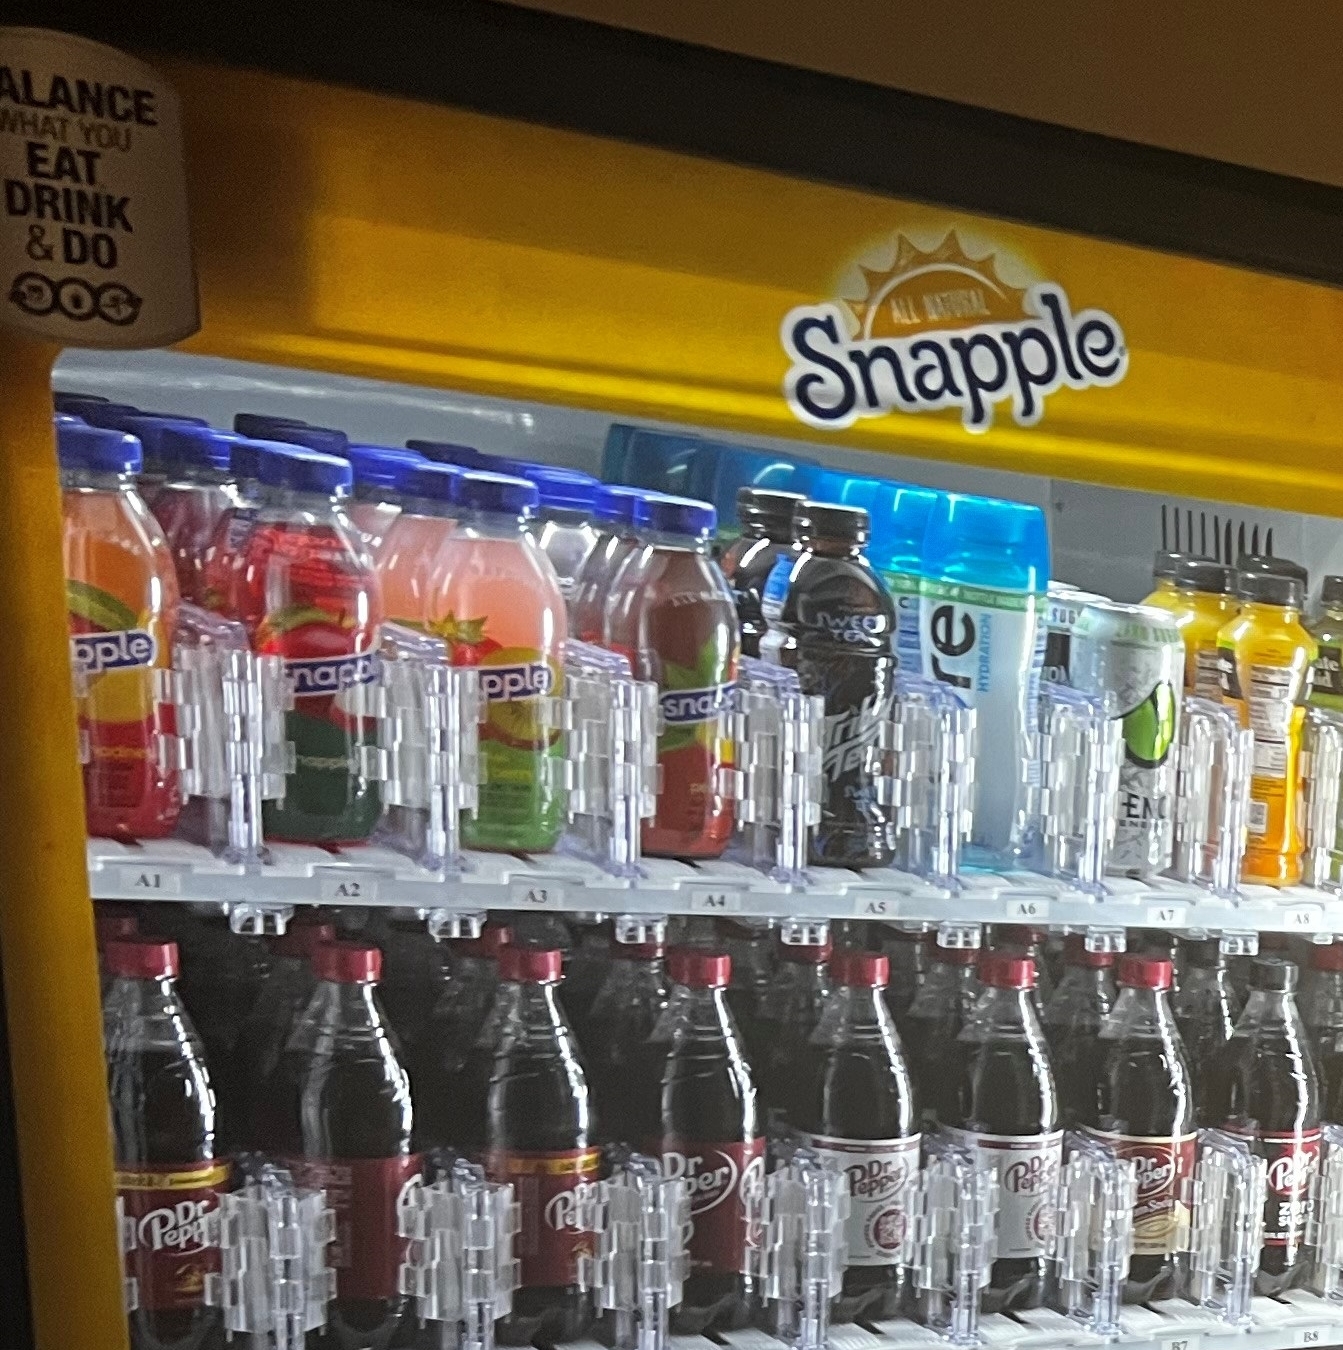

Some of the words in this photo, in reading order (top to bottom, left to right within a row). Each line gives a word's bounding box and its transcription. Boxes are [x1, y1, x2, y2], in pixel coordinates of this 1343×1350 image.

[0, 66, 157, 126] ALANCE
[0, 108, 68, 142] WHAT
[80, 121, 131, 151] YOU
[27, 141, 100, 186] EAT
[5, 179, 133, 232] DRINK
[26, 224, 53, 261] &
[62, 227, 117, 270] DO
[792, 293, 1119, 424] Snapple
[73, 633, 152, 671] pple
[977, 612, 993, 693] HYDRATION
[135, 874, 160, 888] A1
[336, 883, 361, 897] A2
[524, 889, 547, 903] A3
[704, 894, 725, 908] A4
[866, 901, 886, 914] A5
[1017, 902, 1036, 915] A6
[1155, 909, 1175, 922] A7
[1292, 912, 1310, 925] A8
[663, 1152, 703, 1180] Dr
[868, 1159, 892, 1178] Dr
[176, 1200, 209, 1227] Dr
[1304, 1331, 1319, 1342] B8
